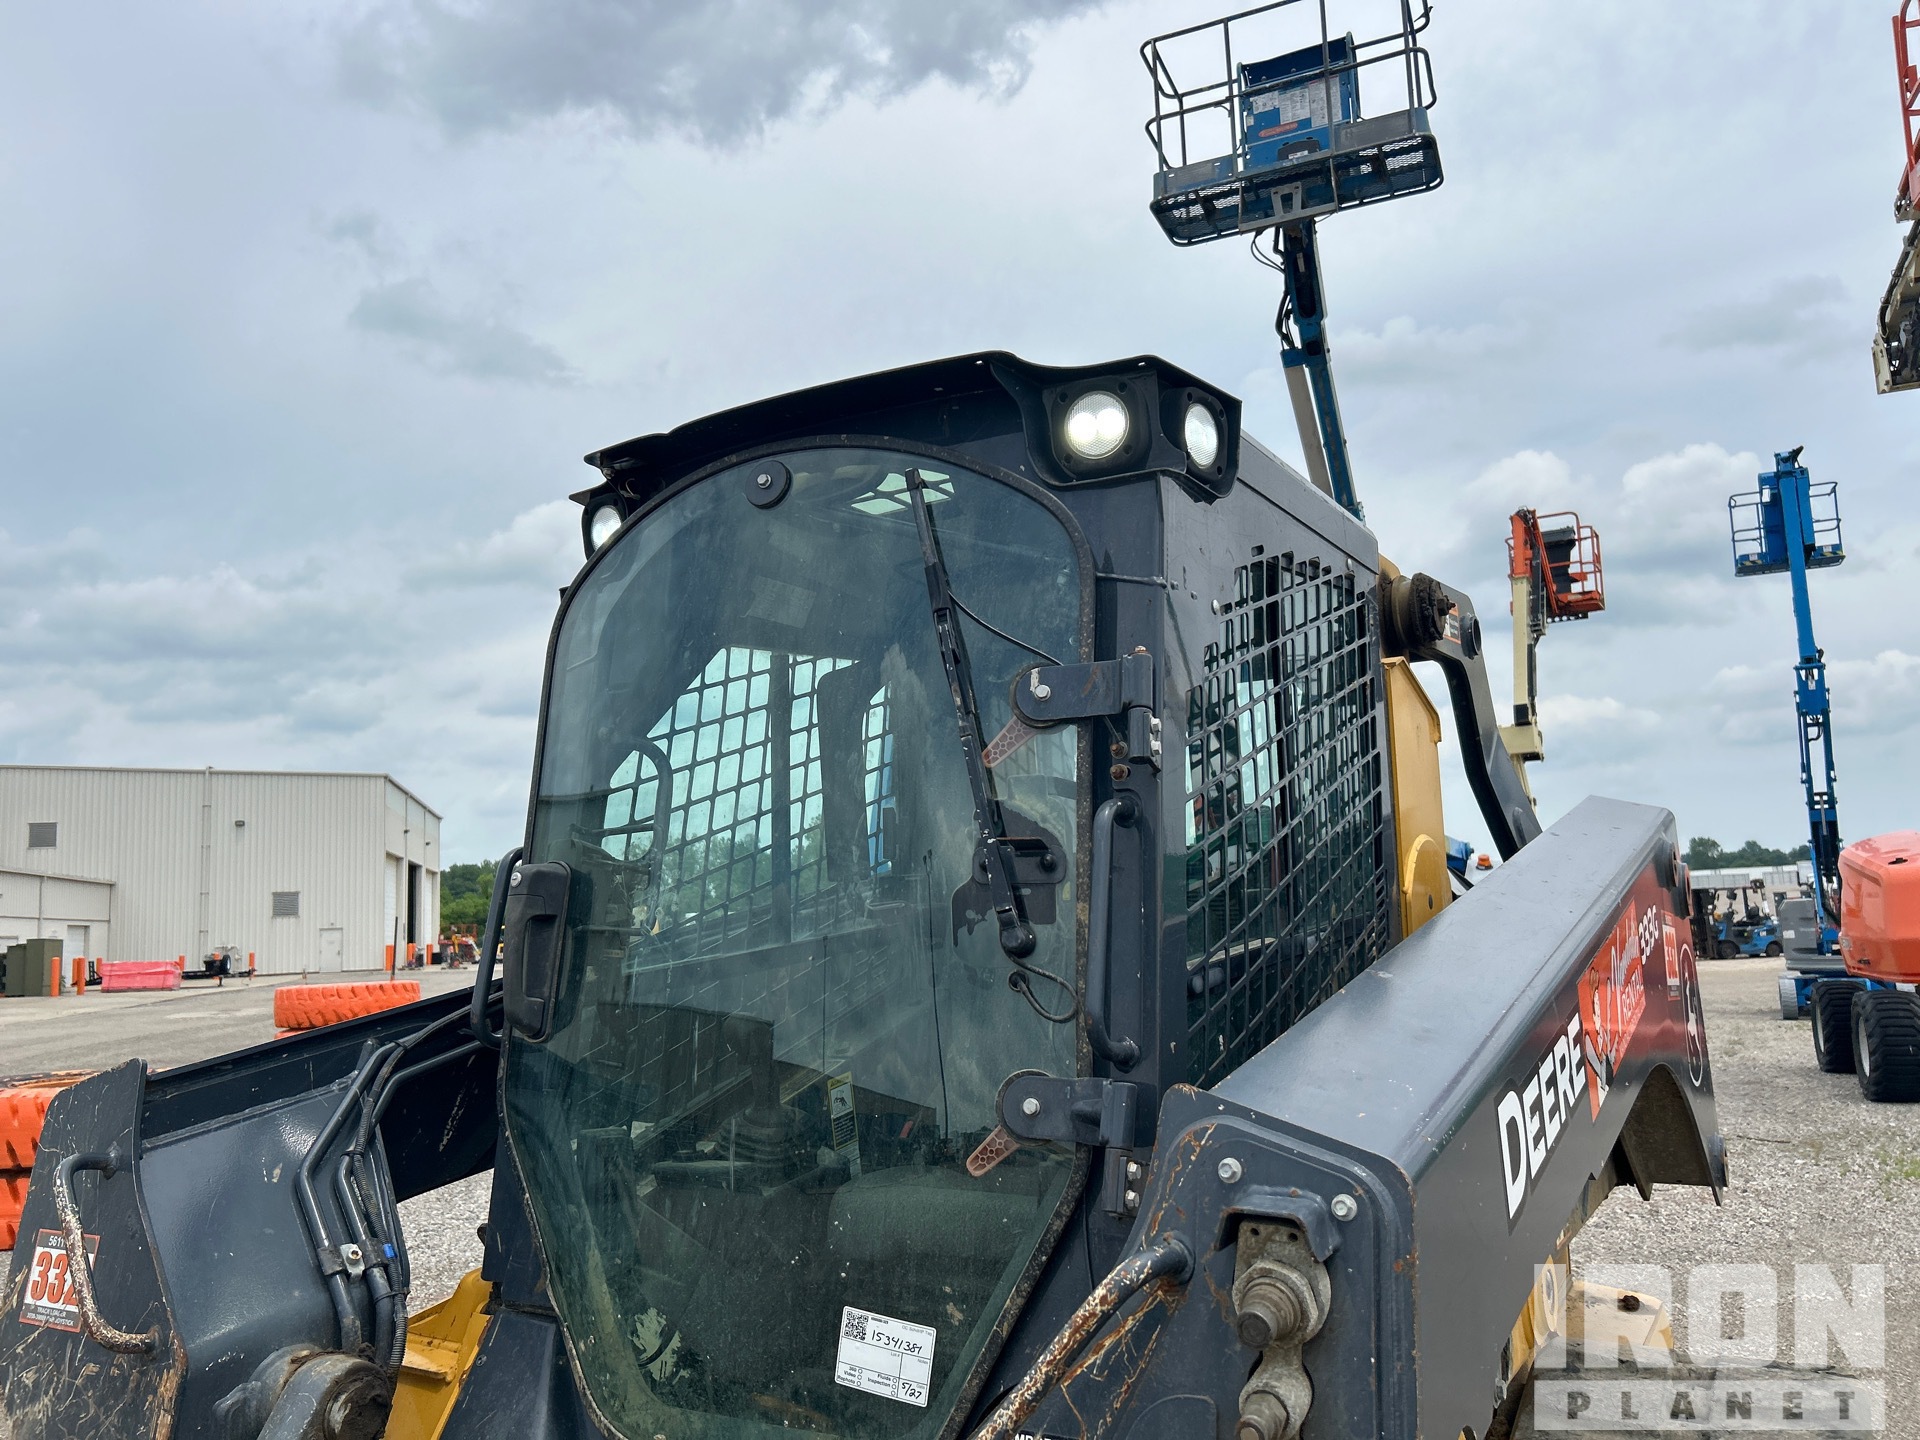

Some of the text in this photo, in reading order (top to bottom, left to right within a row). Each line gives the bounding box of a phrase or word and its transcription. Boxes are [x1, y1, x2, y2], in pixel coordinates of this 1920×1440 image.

[1498, 1012, 1586, 1220] DEERE
[48, 1235, 65, 1247] 5611
[844, 1370, 856, 1378] Video
[877, 1373, 891, 1382] Fluids
[867, 1377, 891, 1387] Inspection
[901, 1382, 922, 1399] 5/27
